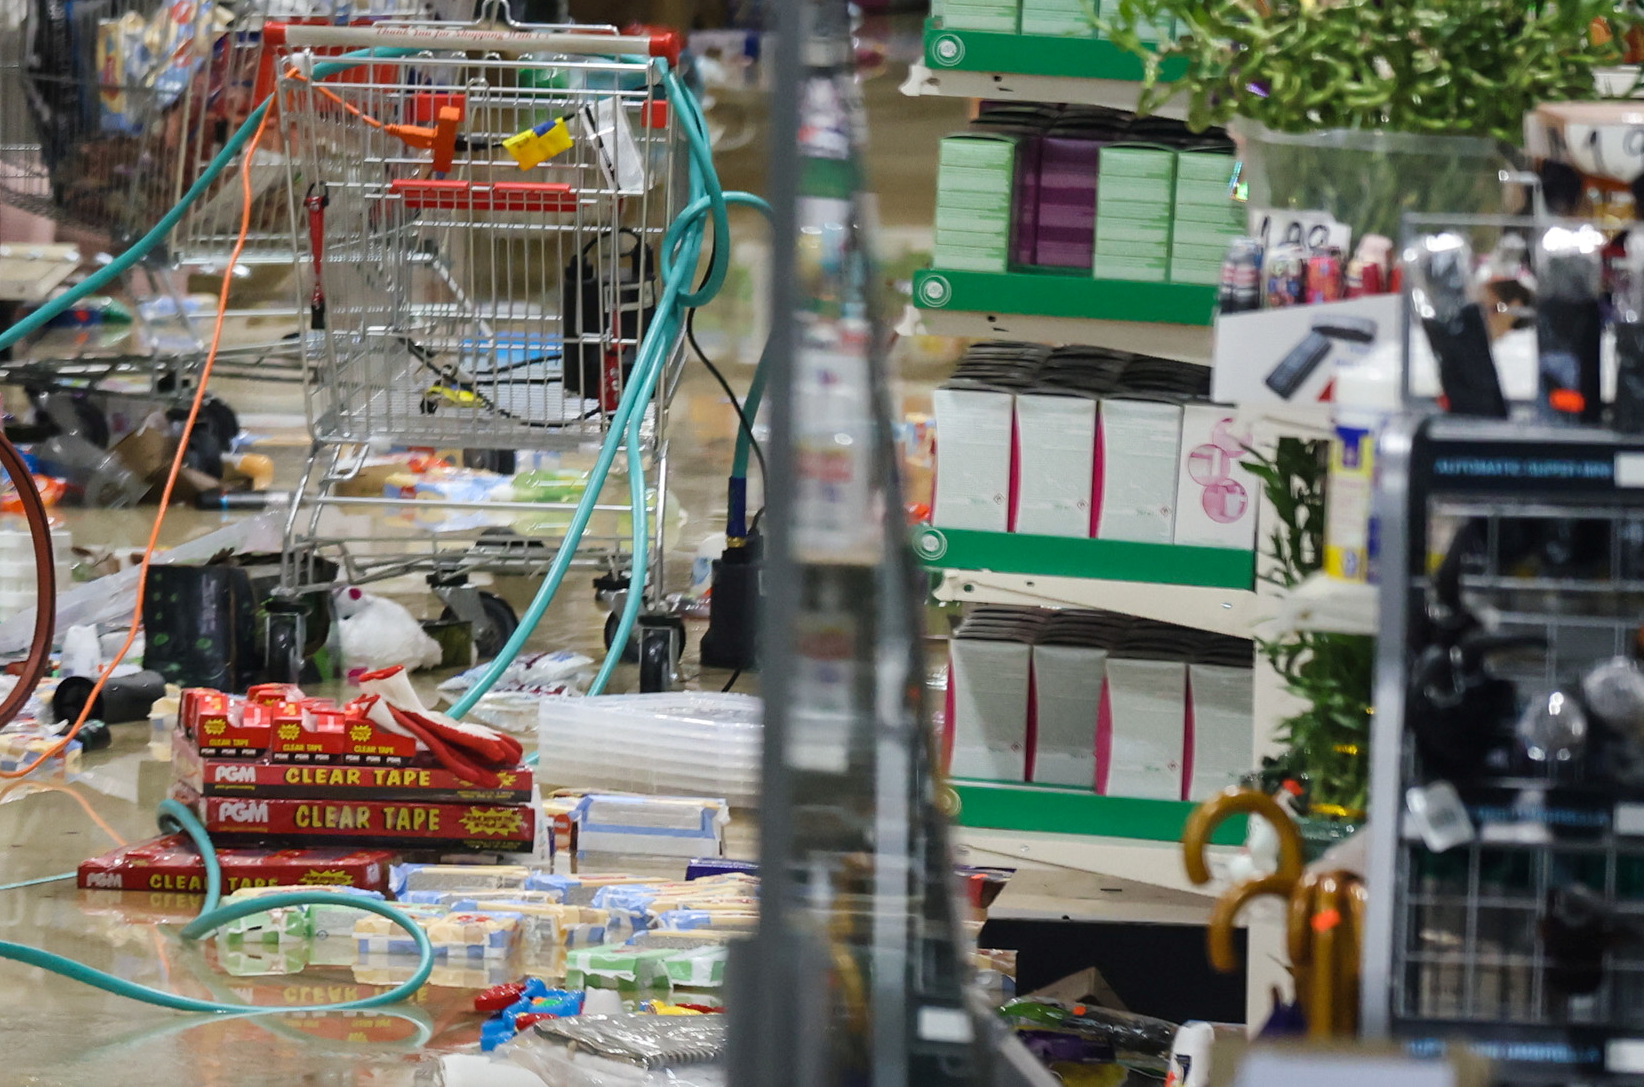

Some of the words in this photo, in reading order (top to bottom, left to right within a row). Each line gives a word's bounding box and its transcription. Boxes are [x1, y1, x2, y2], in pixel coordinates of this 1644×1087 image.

[456, 30, 503, 41] Shopping
[307, 744, 323, 752] TAPE
[354, 745, 376, 753] CLEAR
[378, 746, 395, 754] TAPE
[215, 766, 255, 782] PGM
[285, 767, 360, 784] CLEAR
[374, 769, 430, 786] TAPE
[219, 802, 268, 822] PGM
[295, 805, 370, 829] CLEAR
[383, 806, 440, 830] TAPE
[149, 873, 206, 890] CLEA
